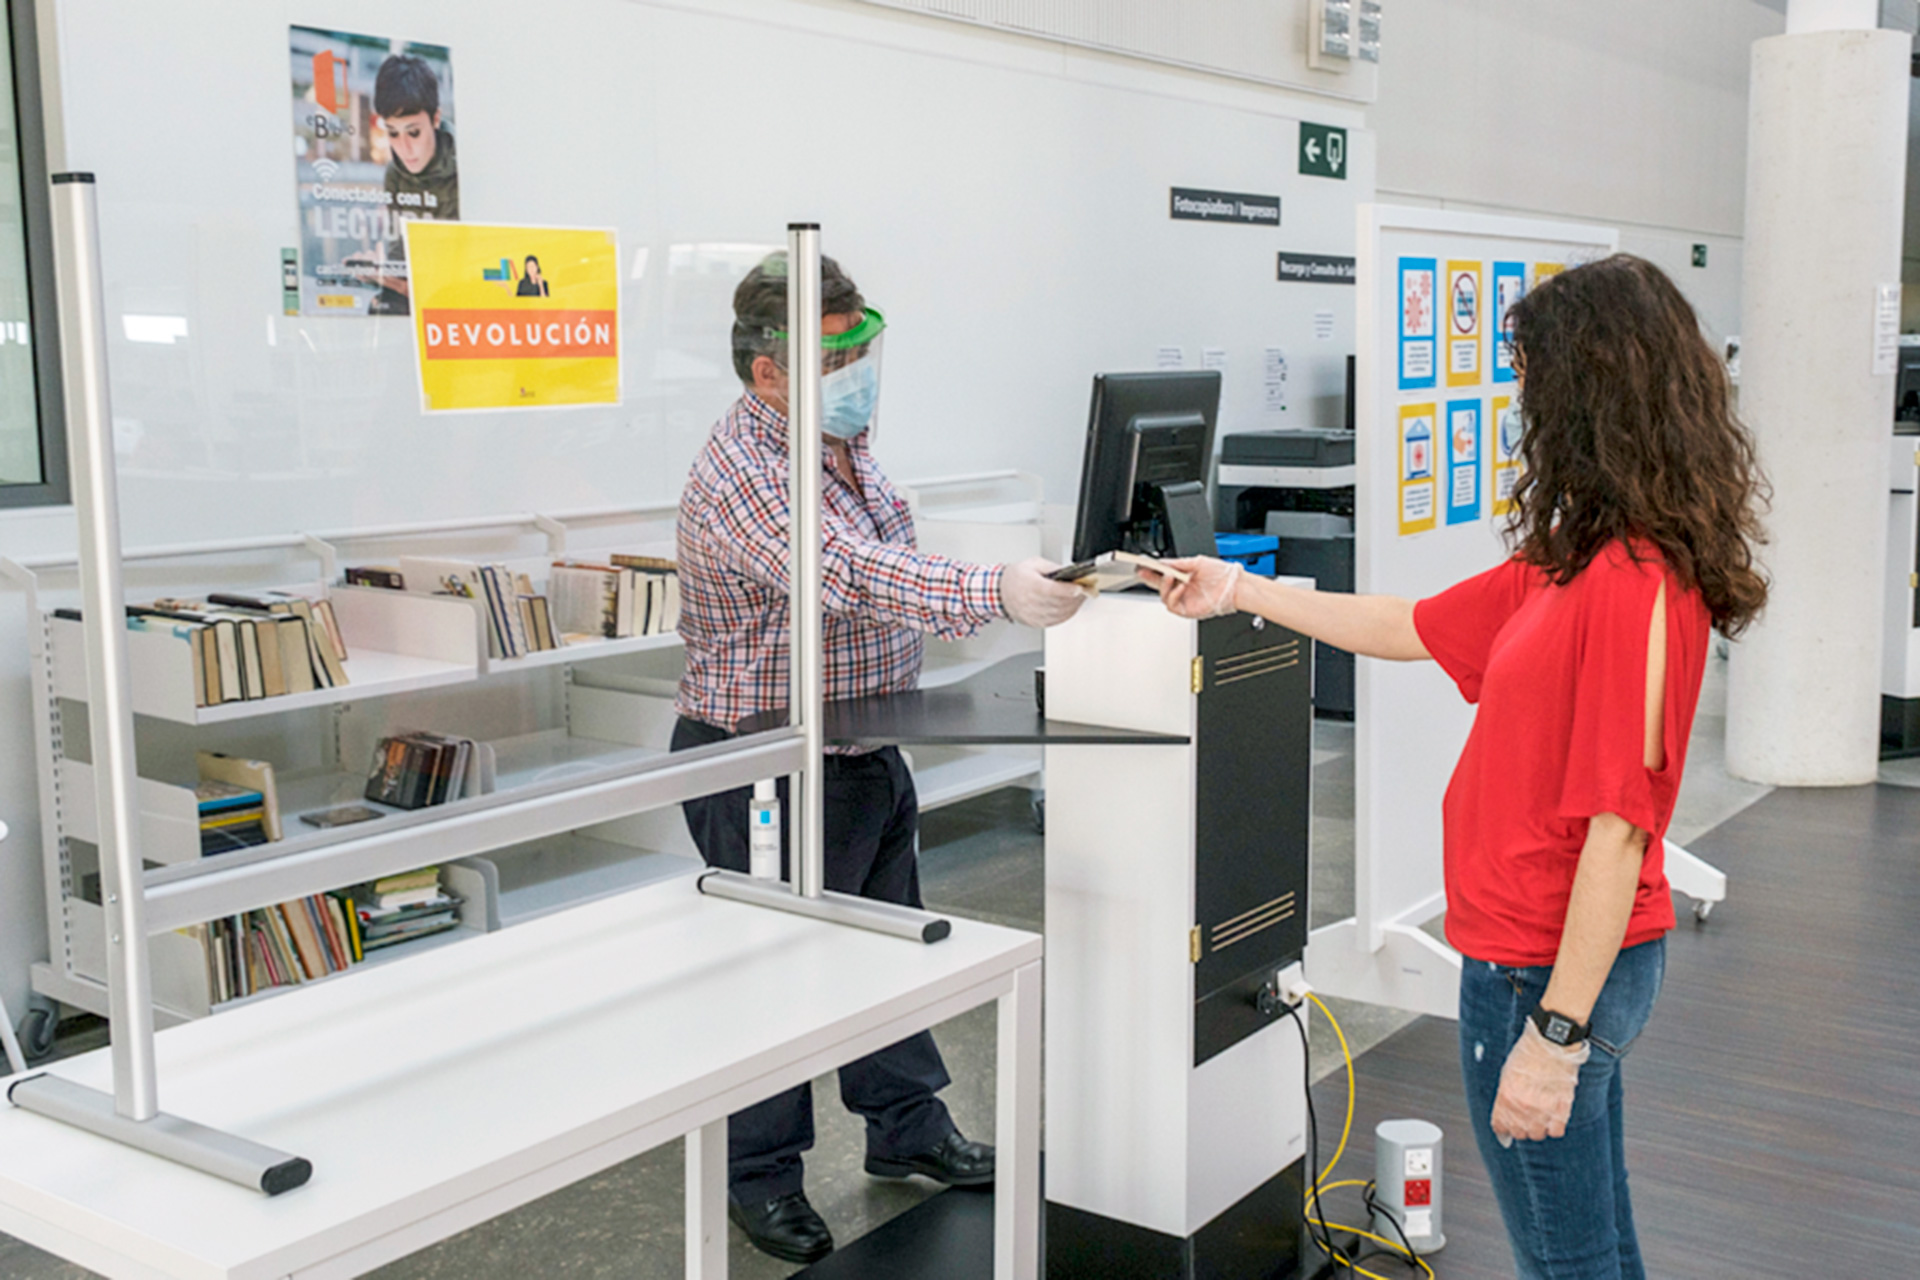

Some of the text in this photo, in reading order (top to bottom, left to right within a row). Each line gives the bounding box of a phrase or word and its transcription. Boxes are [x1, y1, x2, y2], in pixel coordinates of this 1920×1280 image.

[313, 183, 437, 207] Conectados con la
[1174, 196, 1233, 217] Fotocopiadora
[1240, 201, 1277, 220] Impresora
[426, 317, 611, 346] DEVOLUCIÓN
